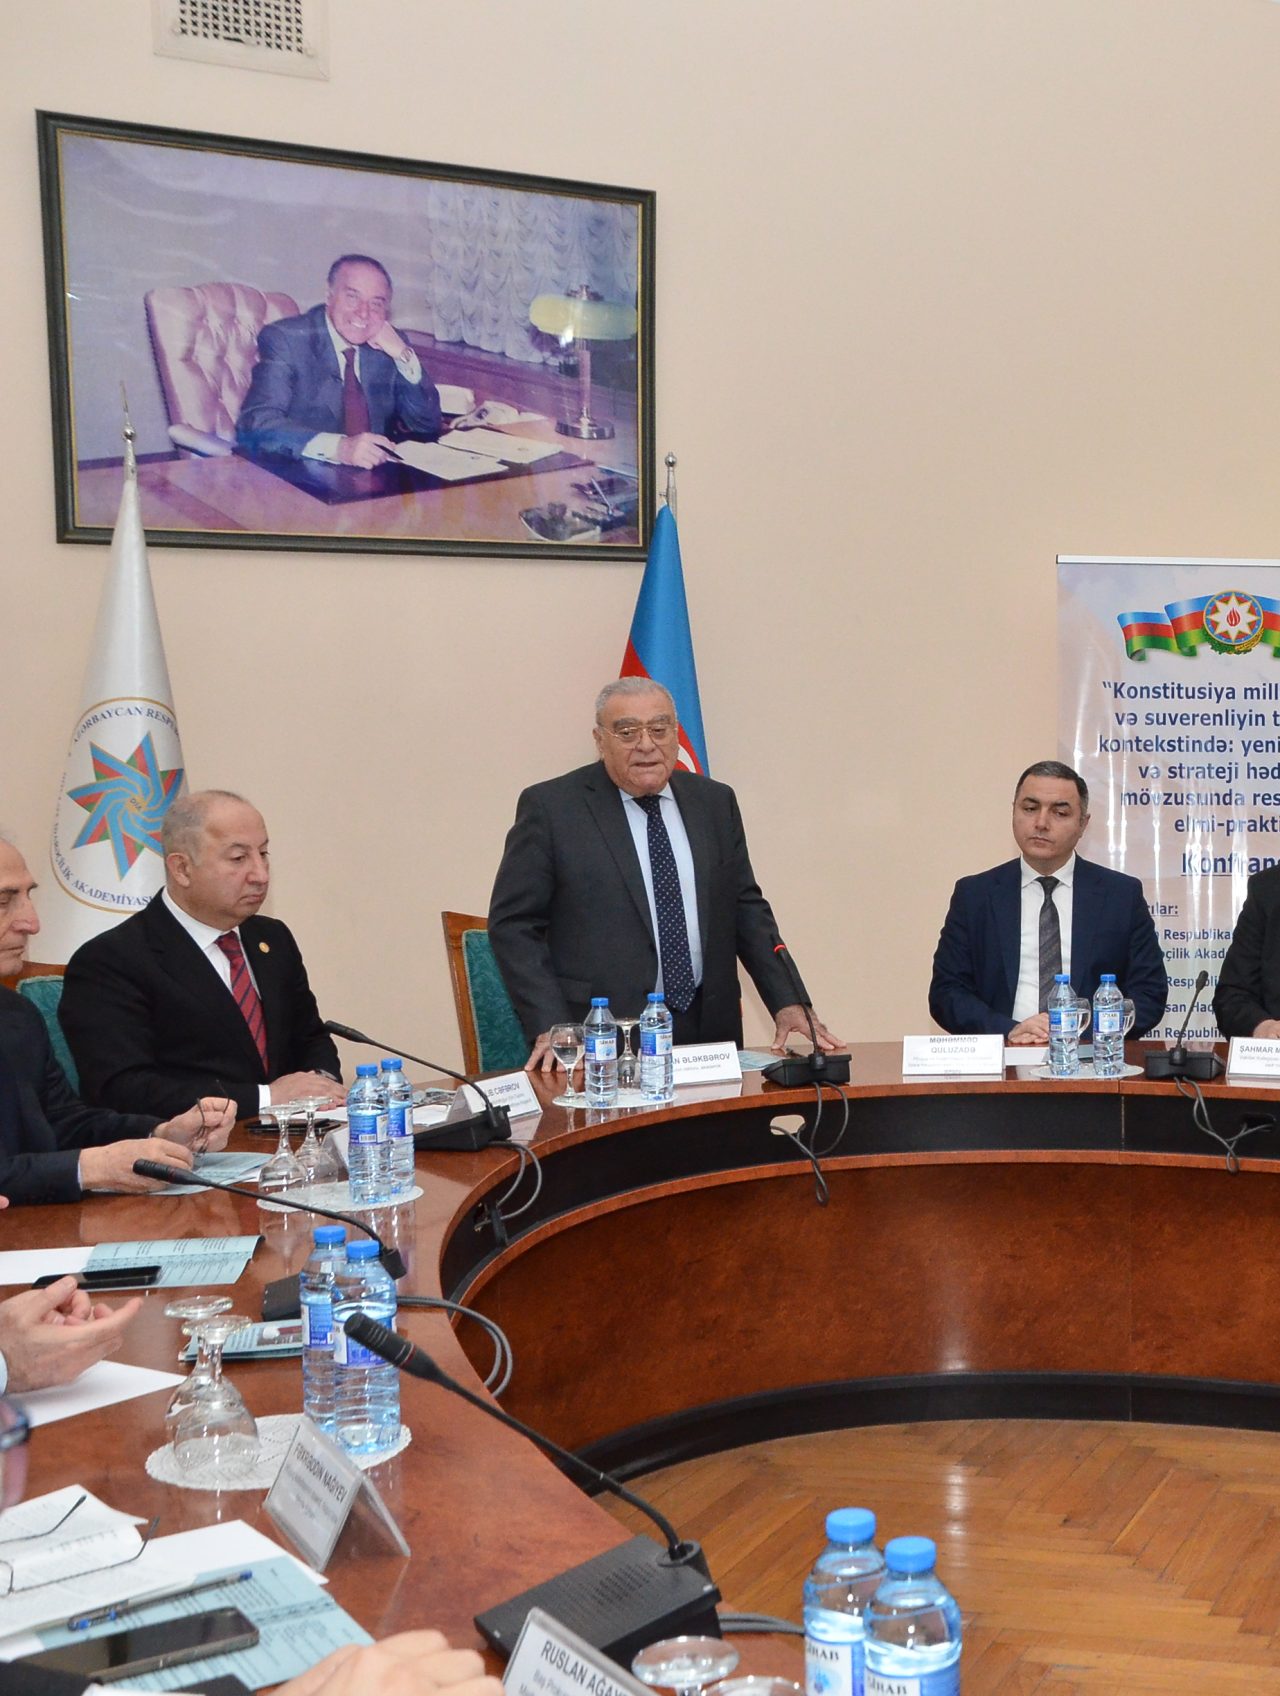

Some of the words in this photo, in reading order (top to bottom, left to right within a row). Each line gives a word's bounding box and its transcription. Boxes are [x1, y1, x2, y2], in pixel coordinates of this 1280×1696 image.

[1115, 712, 1138, 725] və
[1144, 710, 1265, 731] suverenliyin
[1098, 734, 1234, 753] kontekstində:
[1138, 764, 1161, 779] və
[1167, 762, 1239, 784] strateji
[1120, 789, 1246, 806] mövzusunda
[1165, 1003, 1186, 1012] san
[540, 1640, 588, 1686] RUSLAN
